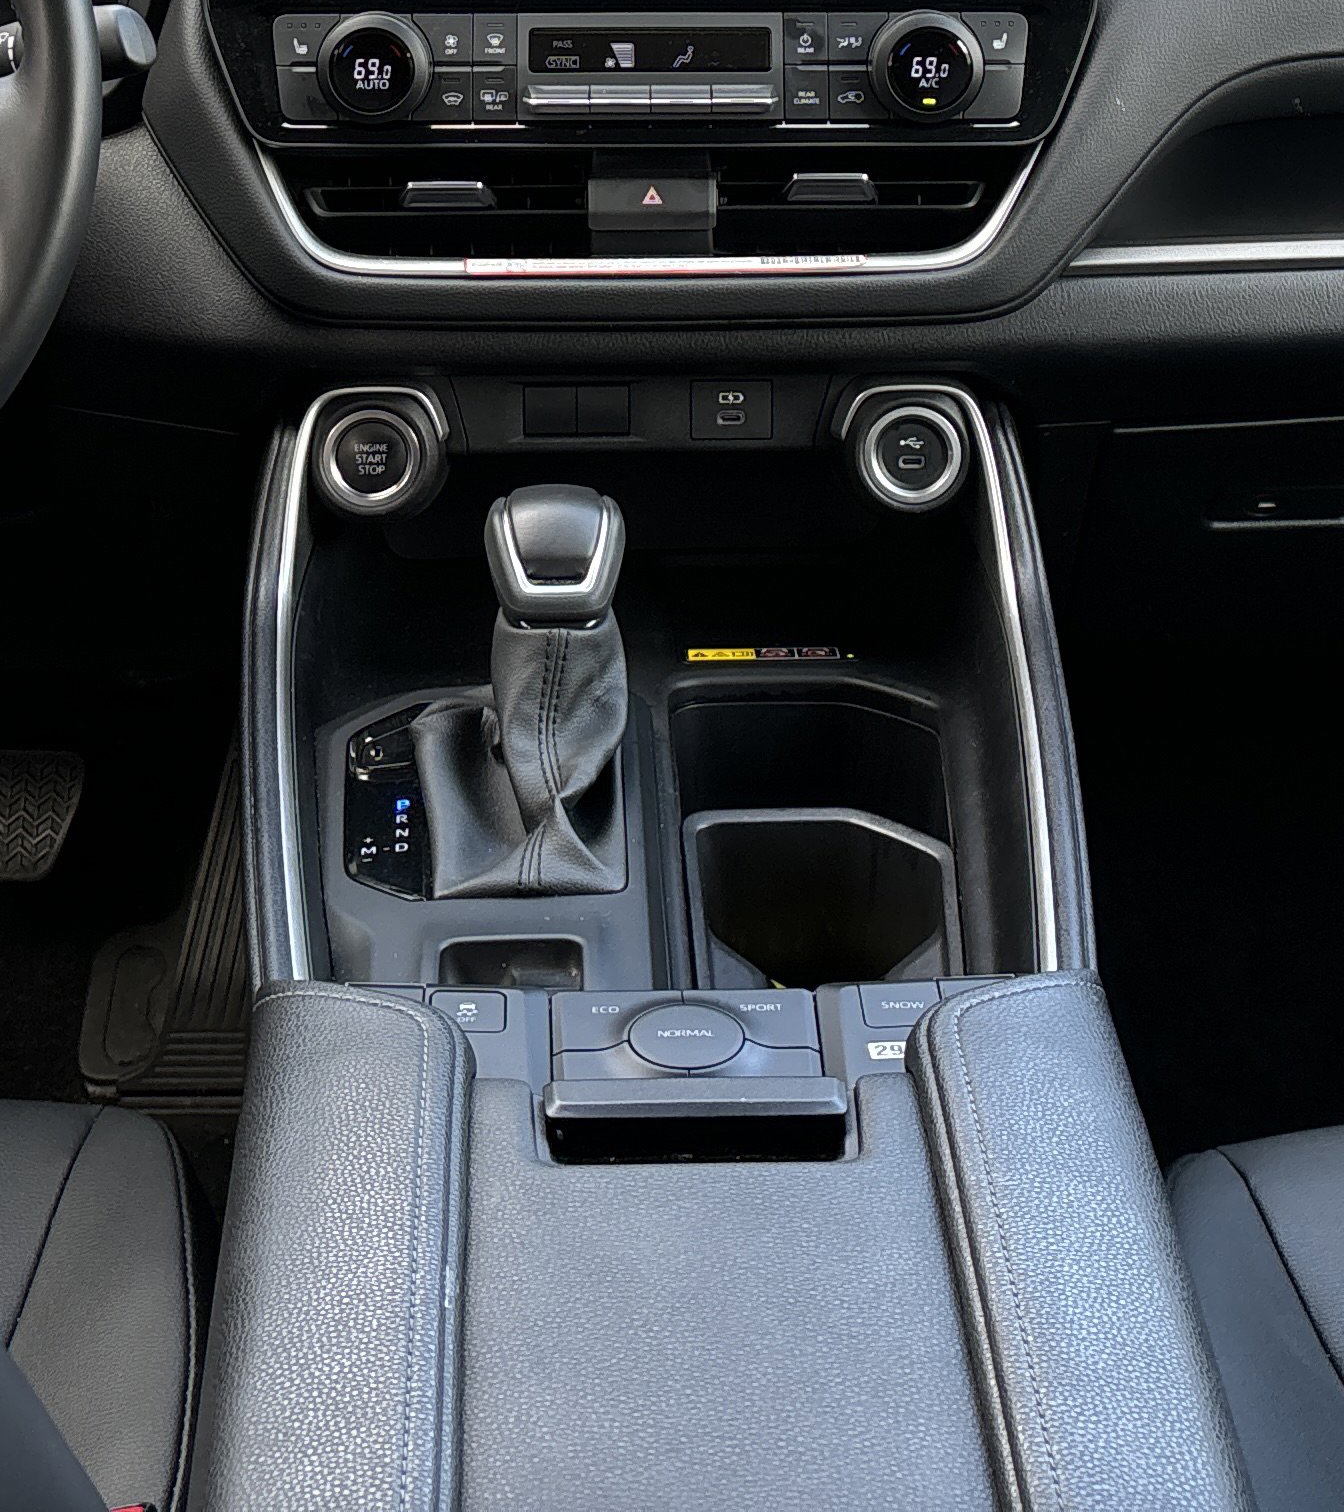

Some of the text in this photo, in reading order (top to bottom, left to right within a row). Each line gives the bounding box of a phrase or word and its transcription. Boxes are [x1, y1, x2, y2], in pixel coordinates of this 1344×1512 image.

[552, 40, 573, 49] PASS
[444, 48, 459, 56] OFF
[484, 47, 506, 55] FRONT
[549, 57, 577, 68] SYNC
[910, 56, 949, 78] 69.0
[353, 58, 392, 80] 69.0
[356, 79, 390, 90] AUTO
[918, 78, 940, 89] A/C
[798, 90, 816, 98] REAR
[793, 97, 820, 105] CLIMATE
[485, 103, 503, 111] REAR
[353, 443, 389, 452] ENGINE
[355, 453, 388, 464] START
[358, 464, 386, 475] STOP
[396, 798, 411, 811] P
[395, 814, 409, 824] R
[395, 827, 410, 838] N
[360, 842, 409, 856] M D
[591, 1005, 620, 1014] ECO
[739, 1003, 783, 1013] SPORT
[881, 1000, 925, 1010] SNOW
[456, 1015, 477, 1024] OFF
[657, 1028, 716, 1038] NORMAL
